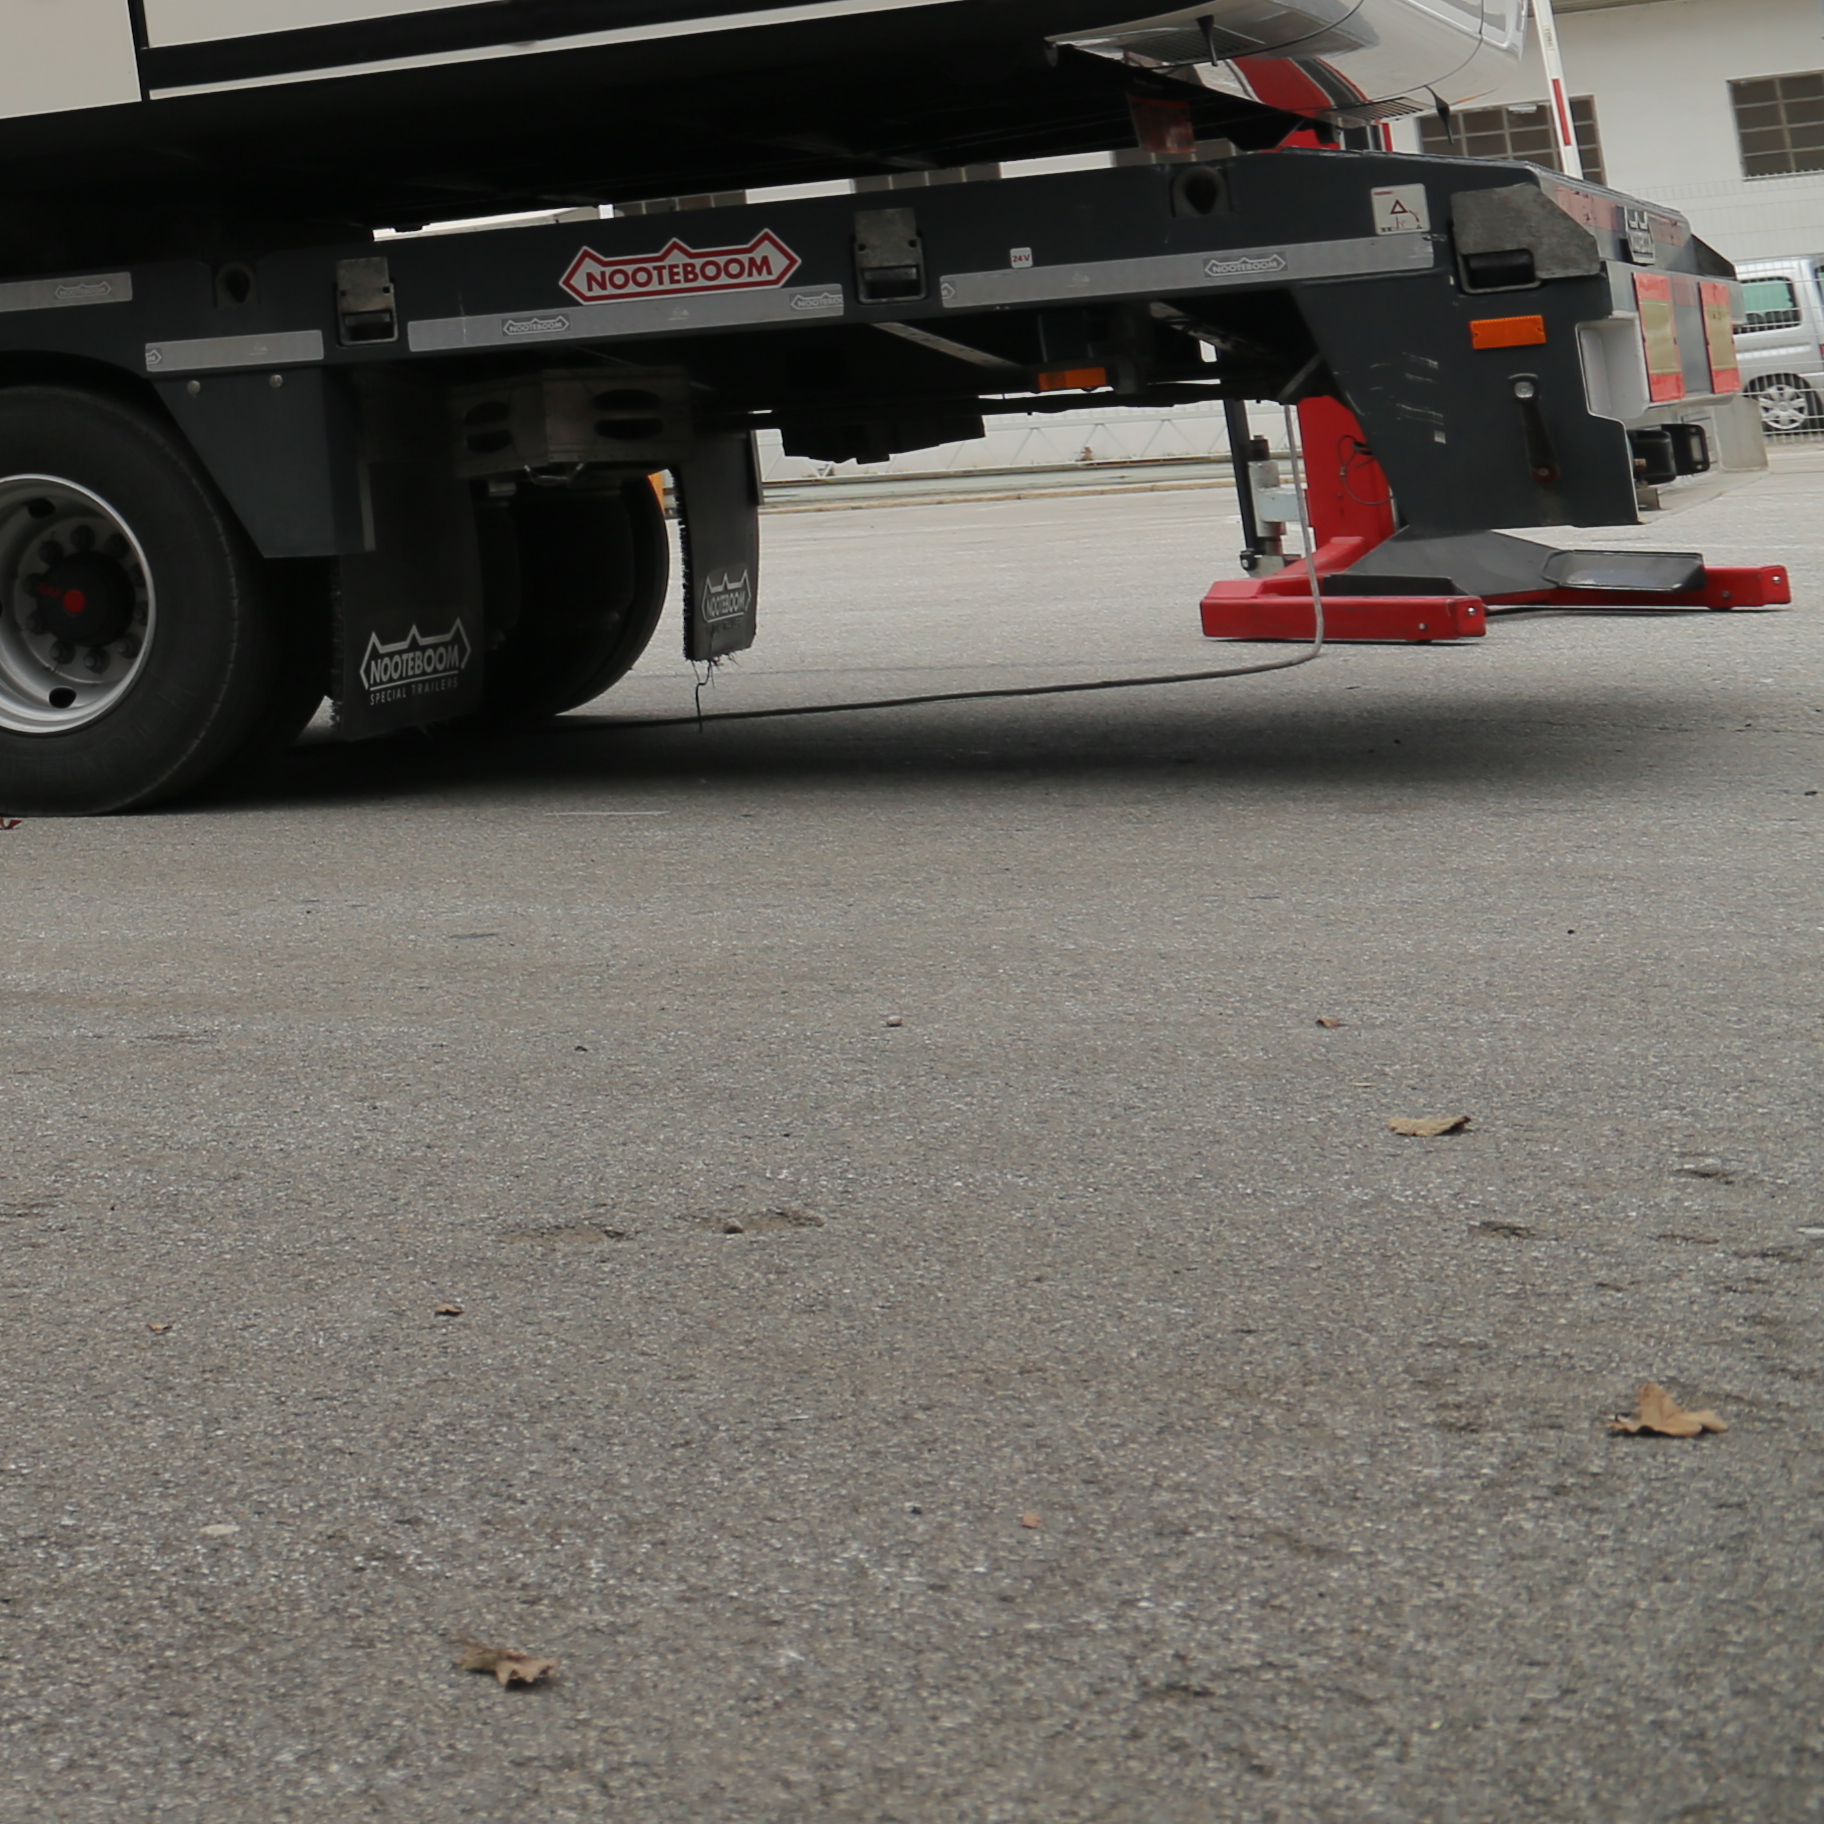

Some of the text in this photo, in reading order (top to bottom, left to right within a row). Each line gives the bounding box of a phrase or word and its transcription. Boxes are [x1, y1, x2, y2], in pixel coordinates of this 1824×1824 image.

[586, 255, 774, 292] NOOTEBOOM
[1213, 261, 1278, 273] NOOTEBOOM
[509, 322, 563, 332] NOOTEBOOM
[370, 644, 459, 685] NOOTEBOOM
[370, 677, 458, 706] SPECIAL TRAILERS
